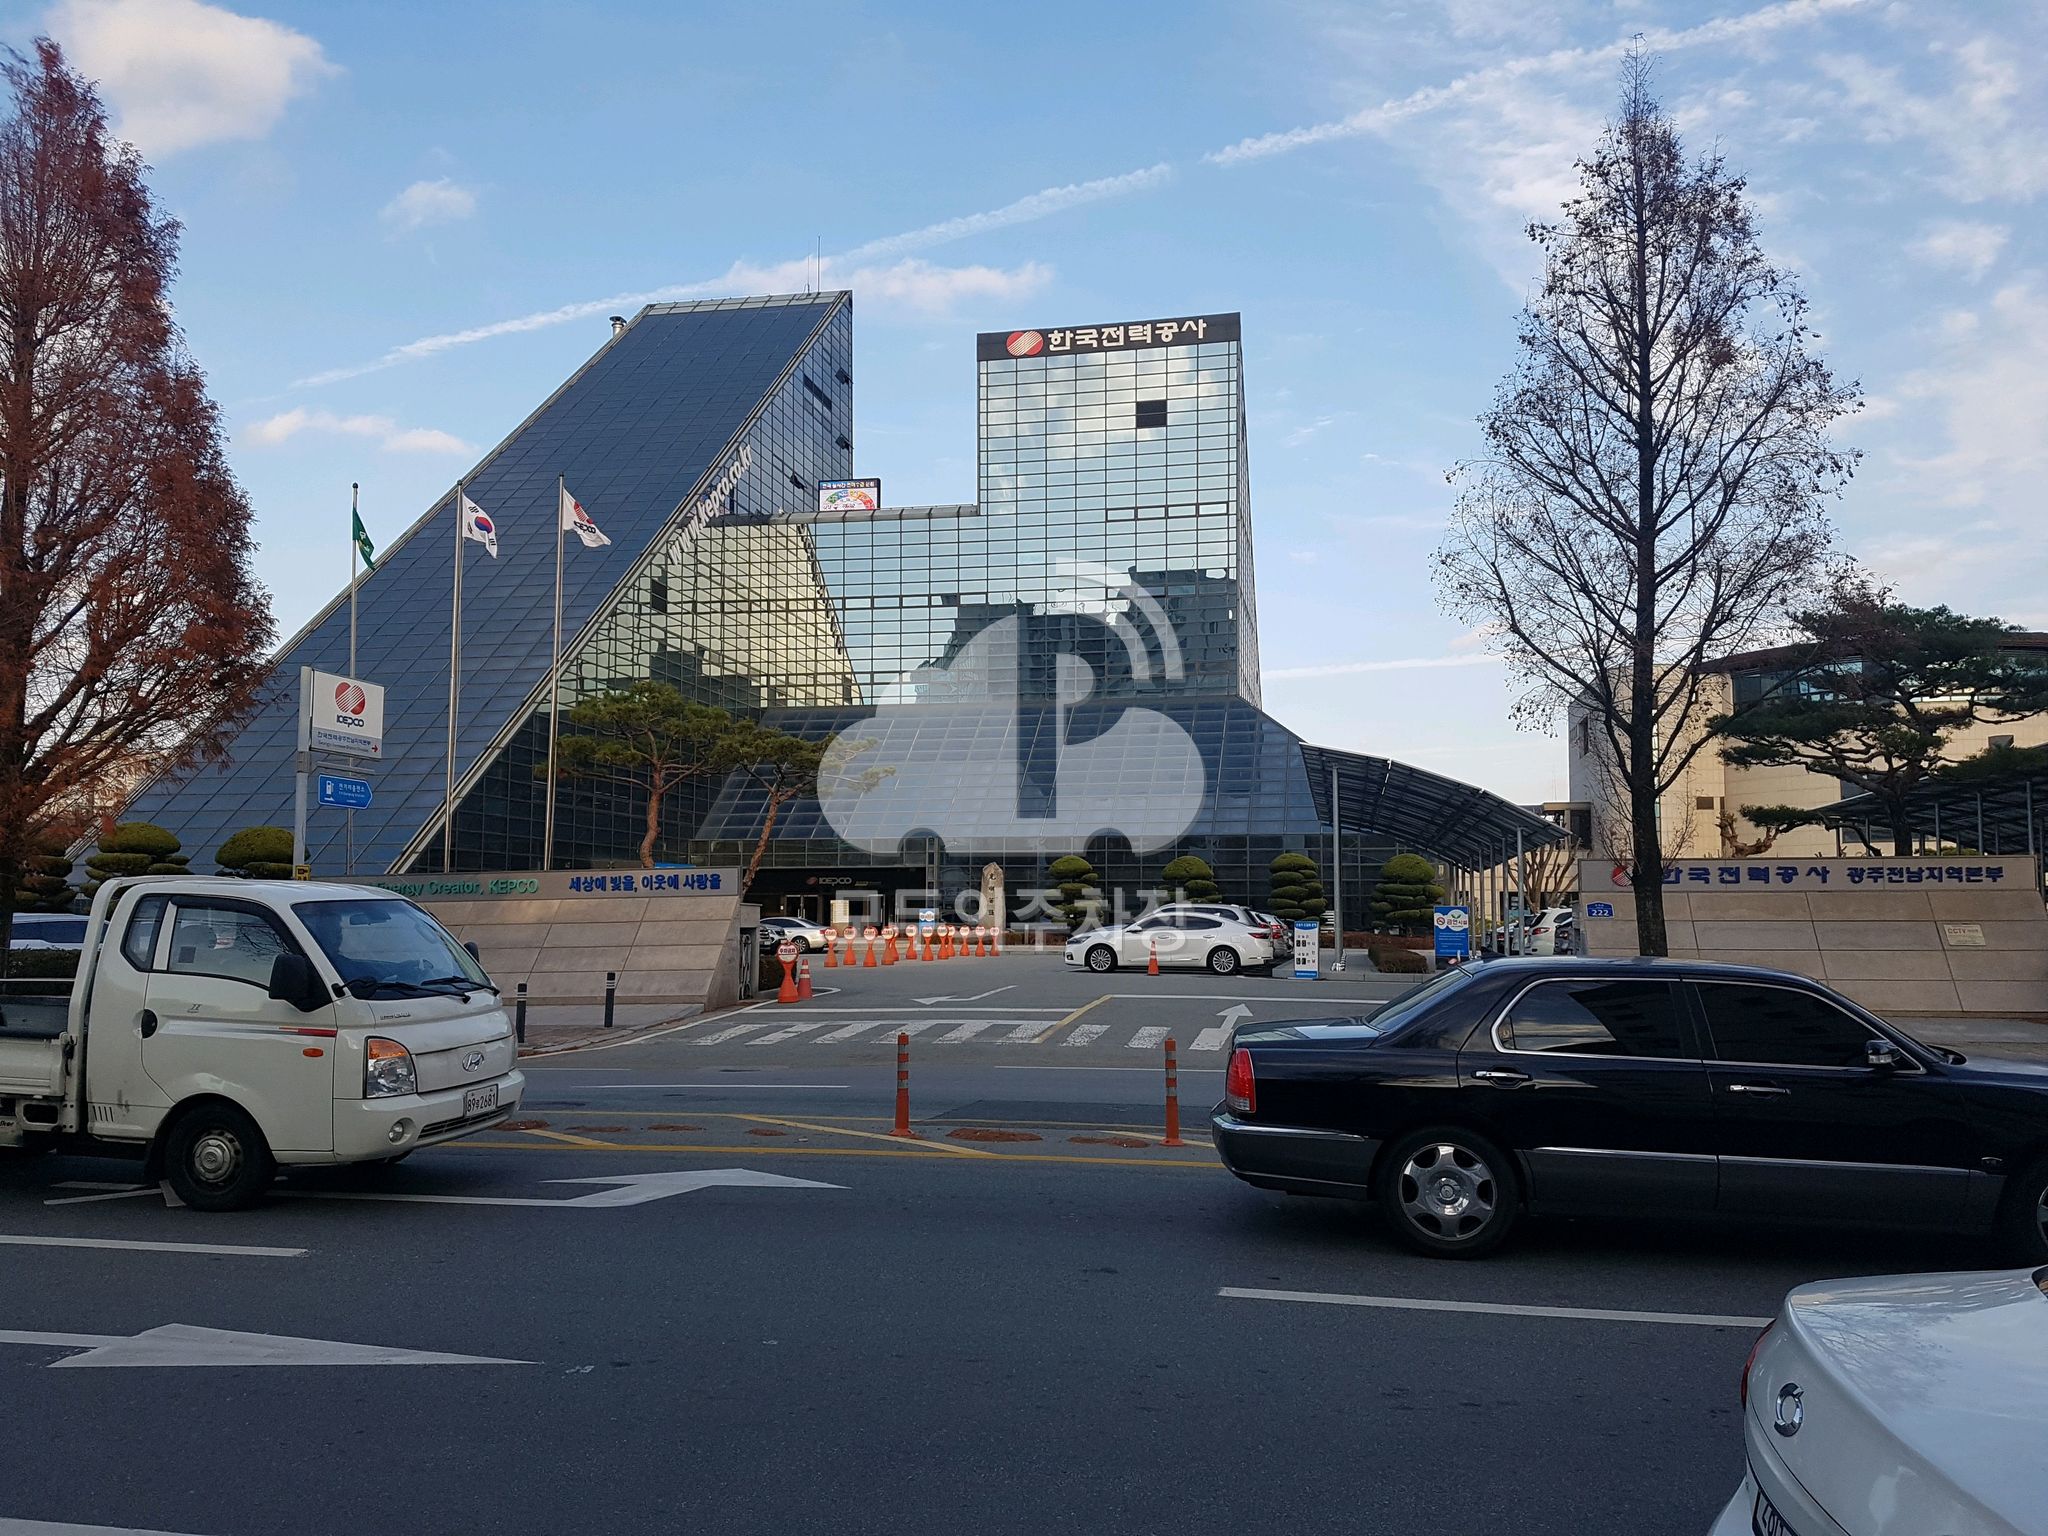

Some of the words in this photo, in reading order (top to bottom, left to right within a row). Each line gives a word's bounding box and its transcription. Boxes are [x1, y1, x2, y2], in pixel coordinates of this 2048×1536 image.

[1048, 319, 1207, 351] 한국전력공사
[668, 444, 752, 565] www.kepco.co.kr
[337, 714, 364, 728] KEPCO
[569, 876, 607, 892] 세상에
[610, 875, 638, 893] 빛을,
[641, 874, 680, 891] 이웃에
[683, 873, 722, 890] 사랑을
[819, 877, 852, 887] KEPCO
[1662, 865, 1831, 885] 한국전력공사
[1846, 866, 2004, 884] 광주전남지역본부
[428, 880, 484, 896] Creator,
[489, 878, 539, 895] KEPCO
